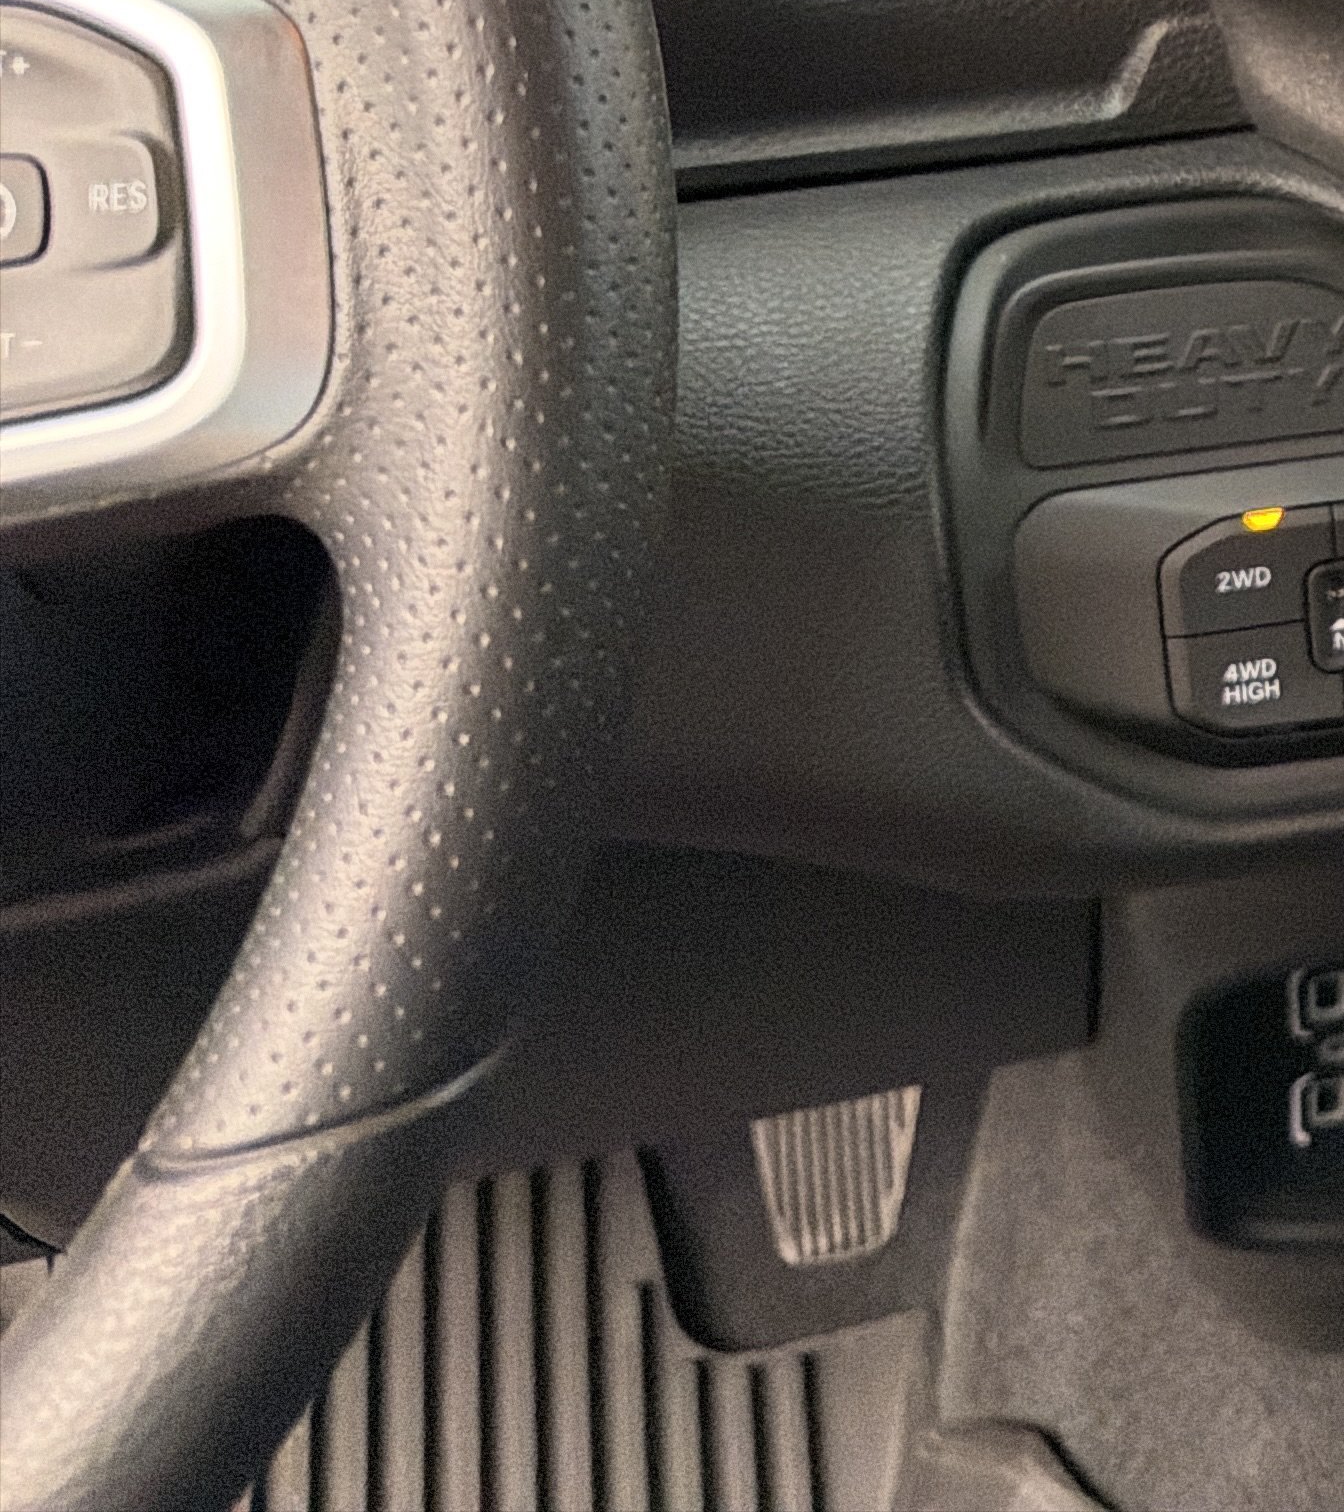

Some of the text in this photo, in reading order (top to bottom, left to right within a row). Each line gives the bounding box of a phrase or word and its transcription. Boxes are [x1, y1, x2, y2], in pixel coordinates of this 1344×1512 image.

[88, 179, 148, 214] RES
[1215, 566, 1272, 594] 2WD
[1223, 658, 1277, 683] 4WD
[1221, 678, 1281, 706] HIGH
